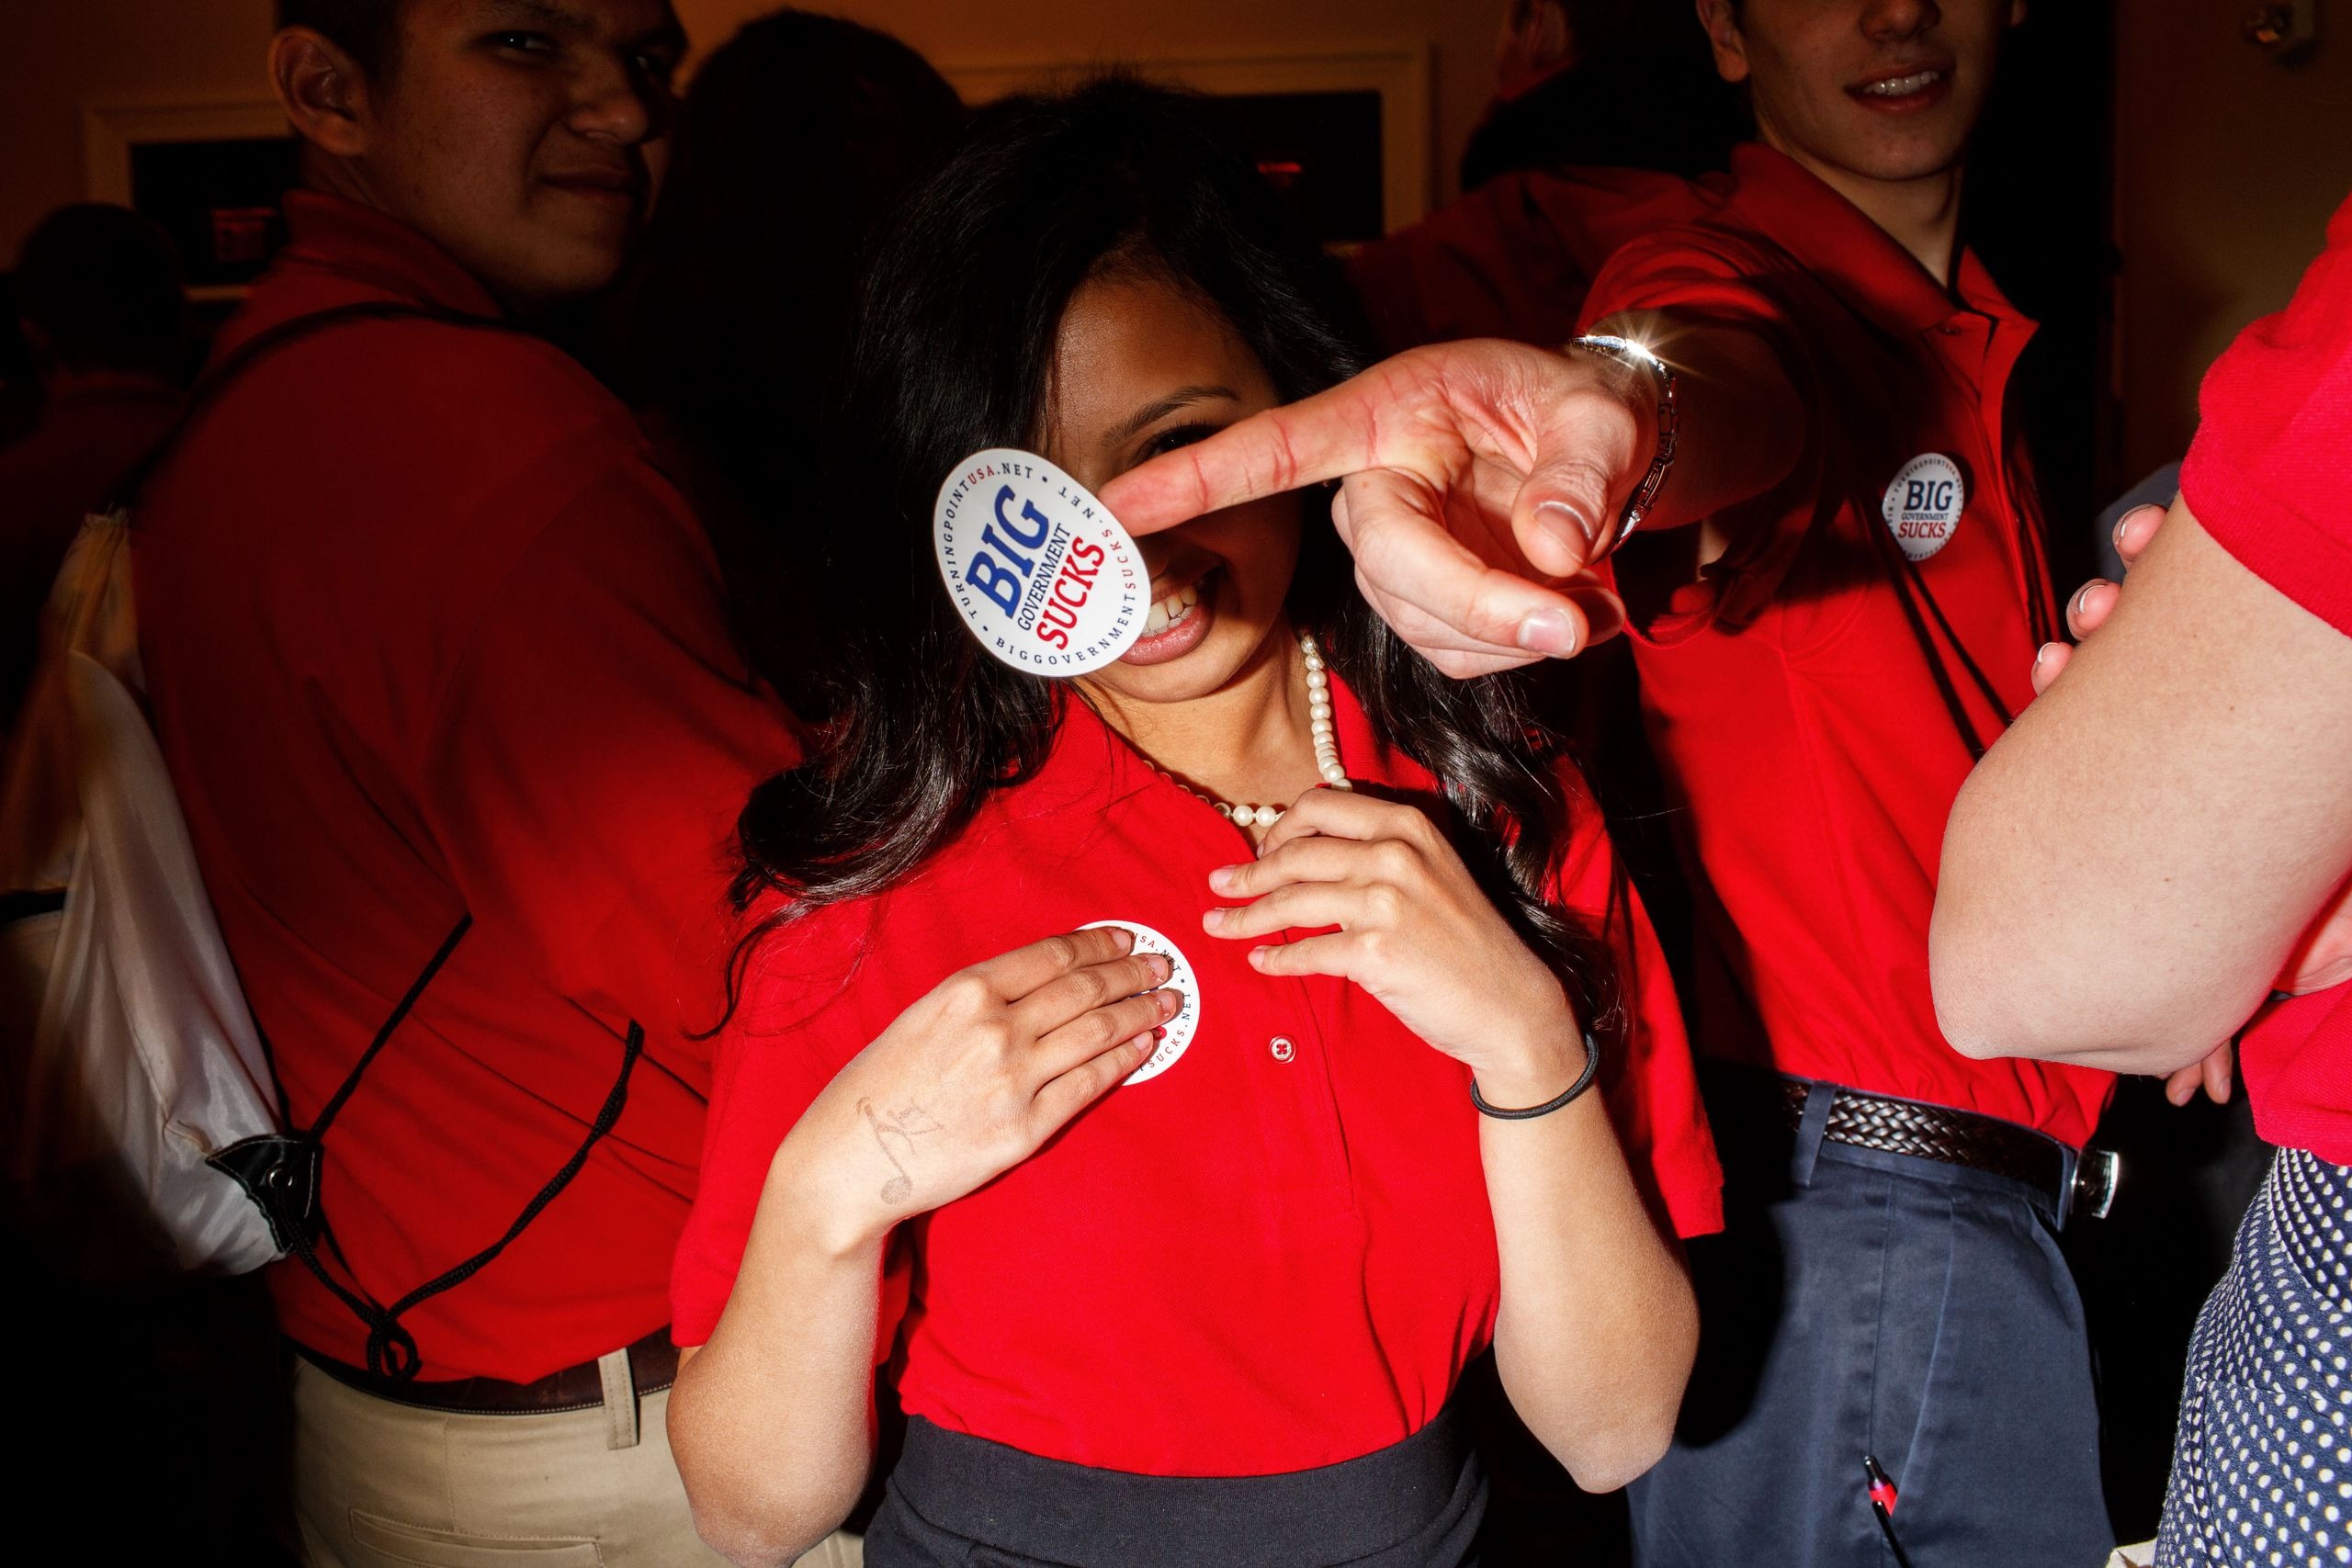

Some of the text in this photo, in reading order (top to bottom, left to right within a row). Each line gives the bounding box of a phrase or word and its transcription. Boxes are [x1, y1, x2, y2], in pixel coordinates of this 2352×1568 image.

[944, 462, 1034, 619] TURNINGPOINTUSA.NET
[1897, 522, 1947, 538] SUCKS
[1901, 513, 1950, 521] GOVERNMENT
[1904, 479, 1954, 511] BIG
[965, 484, 1049, 619] BIG
[996, 487, 1136, 665] BIGGOVERNMENTSUCKS.NET
[1017, 523, 1070, 631] GOVERNMENT
[1036, 536, 1105, 650] SUCKS
